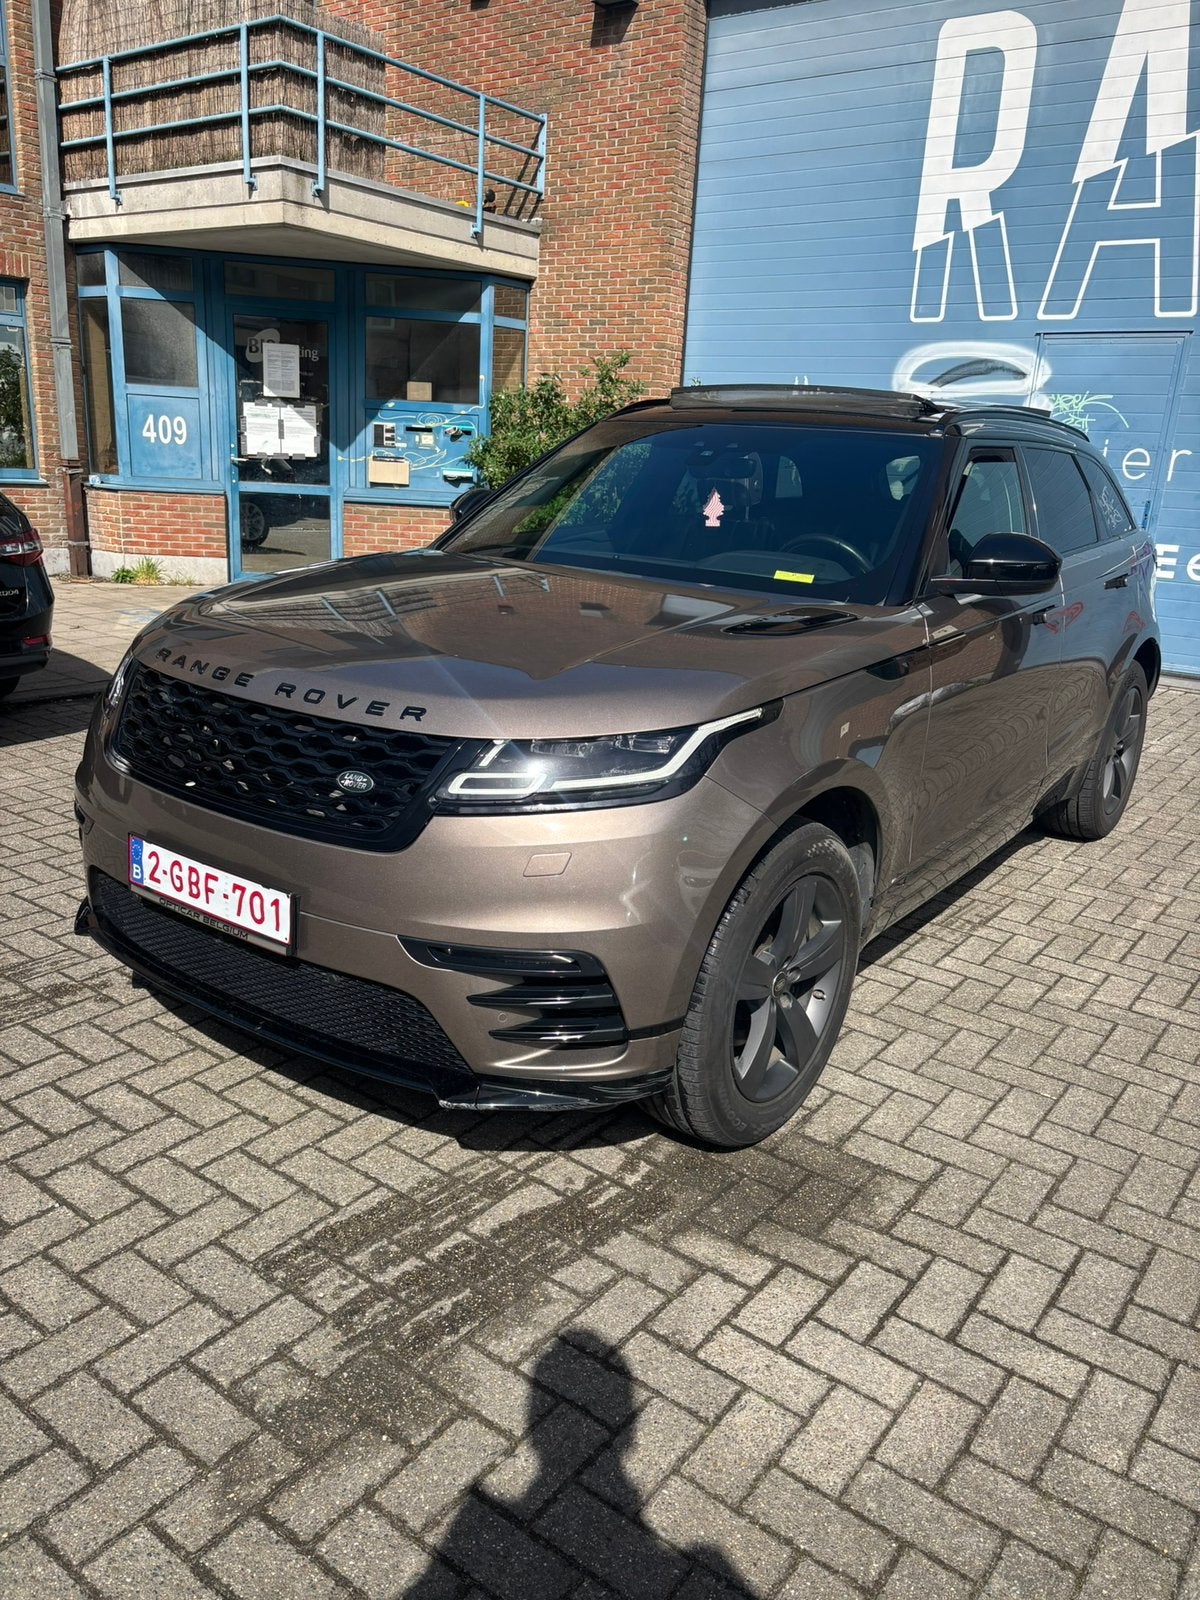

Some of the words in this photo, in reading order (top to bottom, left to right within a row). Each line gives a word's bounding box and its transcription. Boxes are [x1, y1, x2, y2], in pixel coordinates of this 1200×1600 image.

[142, 414, 187, 445] 409
[155, 647, 255, 688] RANGE
[274, 682, 428, 722] ROVER
[343, 779, 368, 790] ROVER
[344, 772, 364, 782] LAND
[132, 863, 142, 880] B
[148, 850, 281, 932] 2-GBF-701
[159, 897, 200, 921] OPTICAR
[202, 915, 249, 941] BELGIUM
